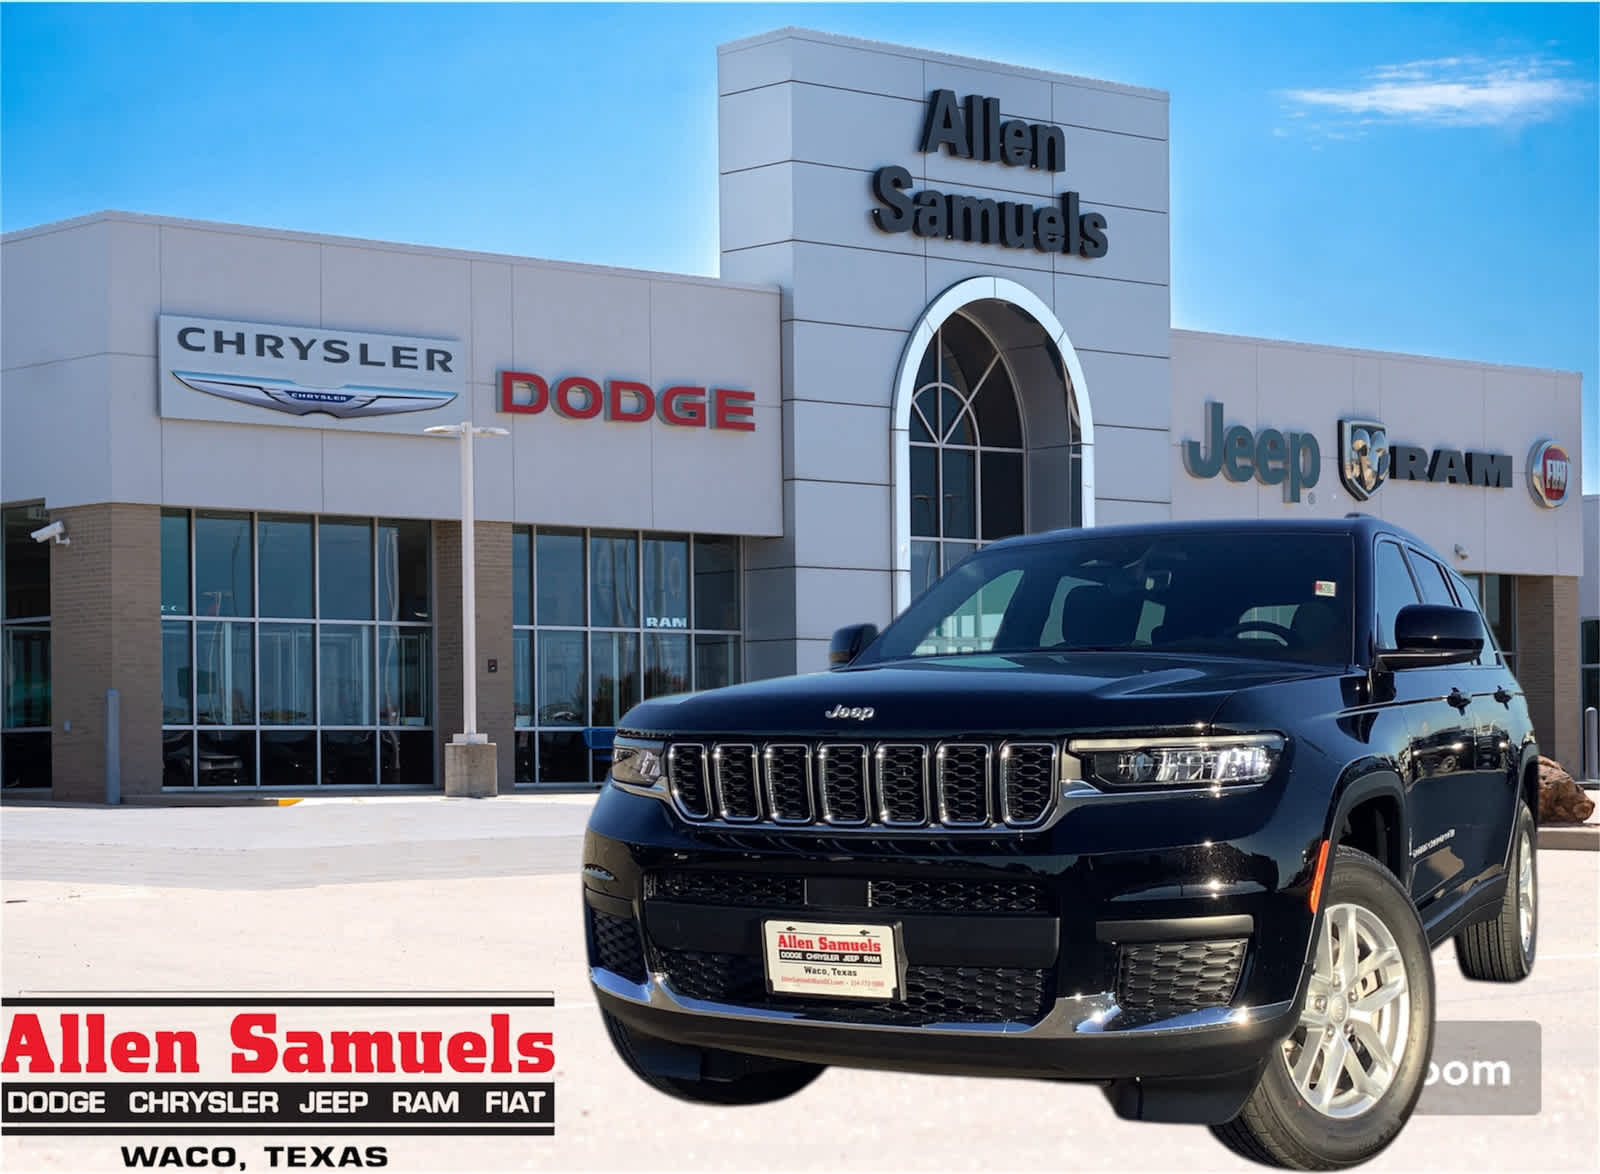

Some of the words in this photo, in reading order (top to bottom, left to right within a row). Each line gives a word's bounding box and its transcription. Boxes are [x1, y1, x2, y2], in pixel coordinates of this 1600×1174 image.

[919, 89, 1066, 172] Allen
[872, 165, 1109, 258] Samuels
[177, 326, 454, 373] CHRYSLER
[291, 392, 347, 401] CHRYSLER
[497, 371, 757, 432] DODGE
[1183, 401, 1321, 503] Jeep
[1389, 445, 1513, 488] RAM
[1546, 459, 1567, 490] FIAT
[646, 617, 688, 628] RAM
[825, 704, 875, 721] Jeep
[778, 934, 814, 950] Allen
[818, 937, 881, 952] Samuels
[804, 966, 830, 976] Waco,
[832, 967, 857, 976] Texas
